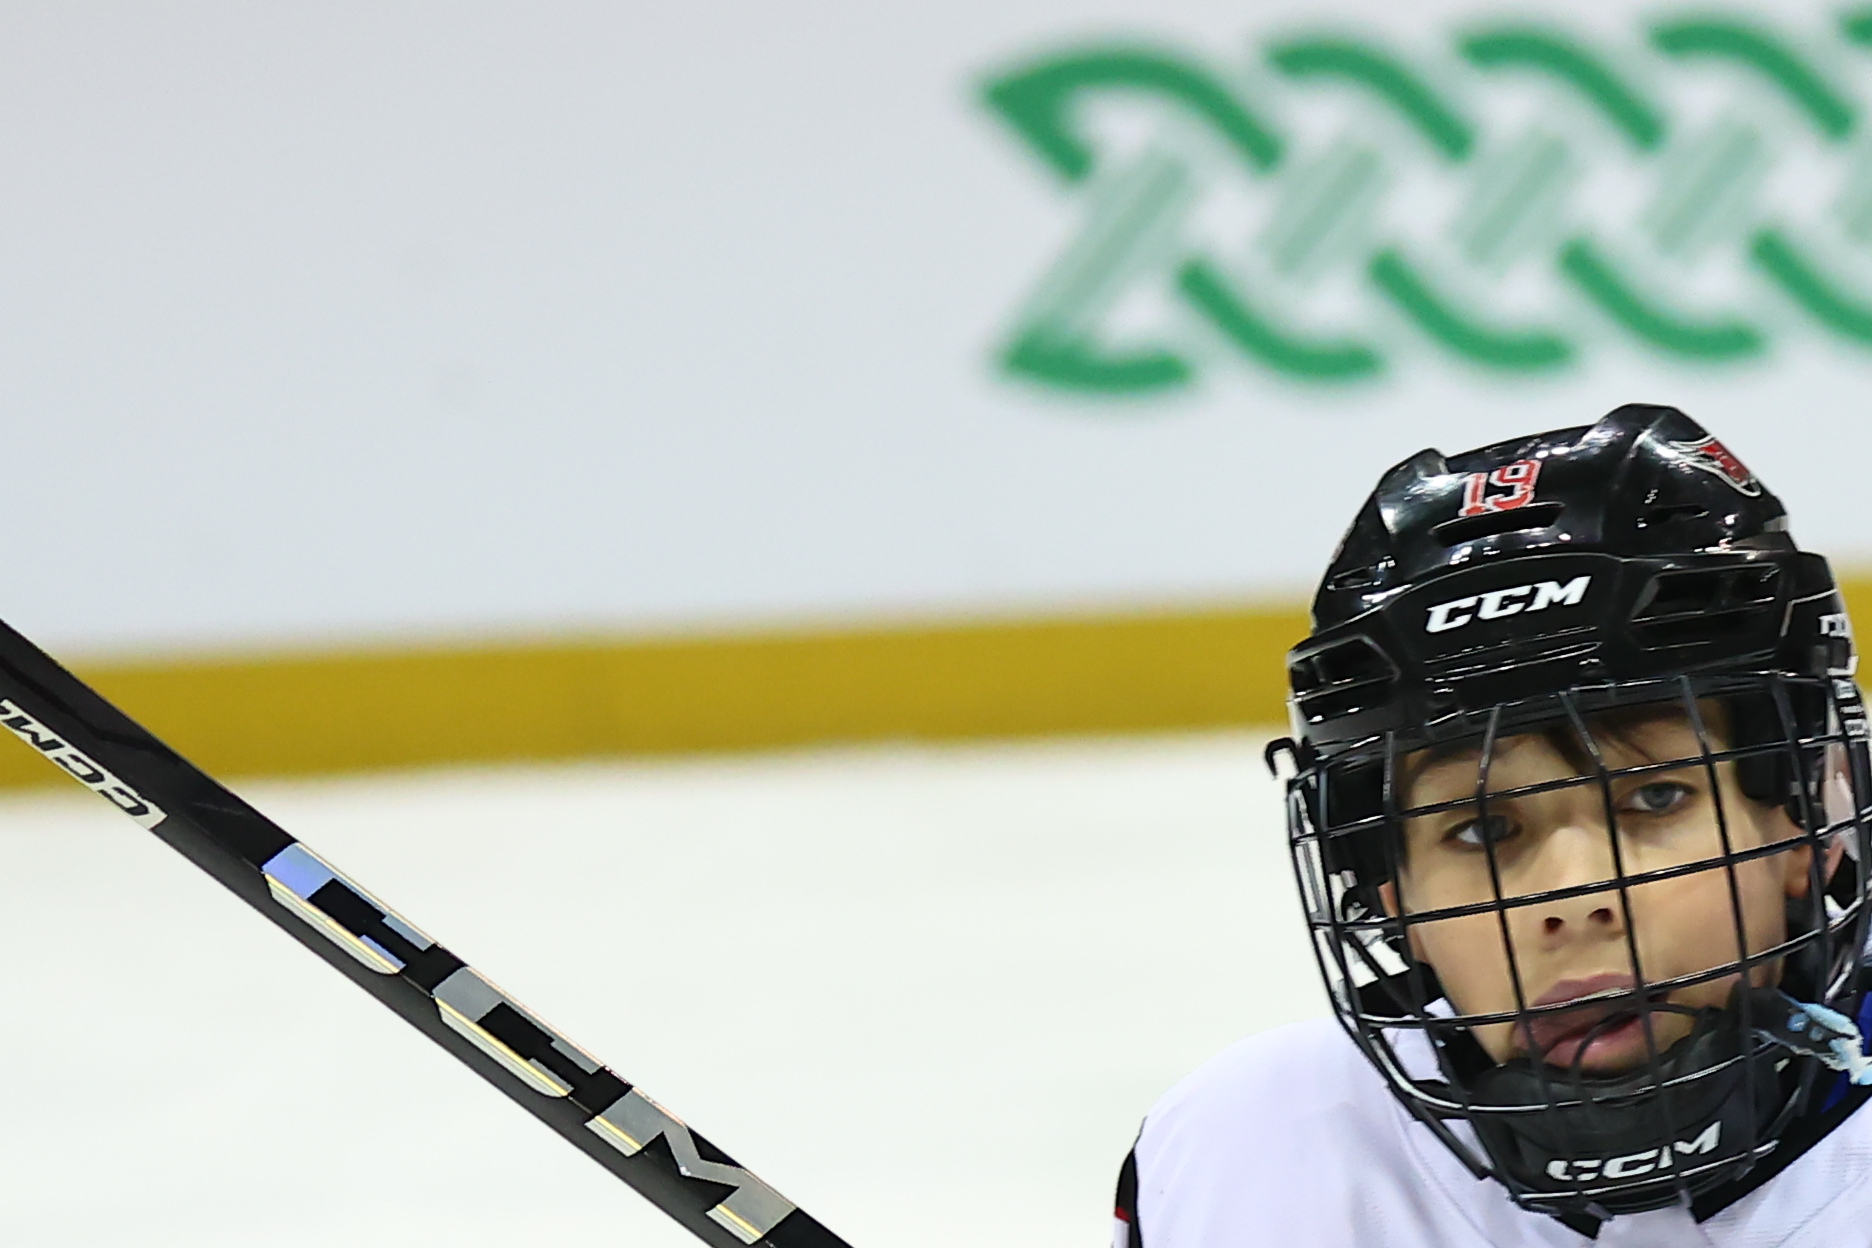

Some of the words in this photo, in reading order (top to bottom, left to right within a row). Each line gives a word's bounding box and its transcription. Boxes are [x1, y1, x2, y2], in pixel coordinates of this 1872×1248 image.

[1458, 459, 1542, 517] 19
[1425, 575, 1592, 634] CCM
[1, 715, 150, 817] CCM
[262, 842, 796, 1246] CCM
[1545, 1121, 1722, 1183] CCM
